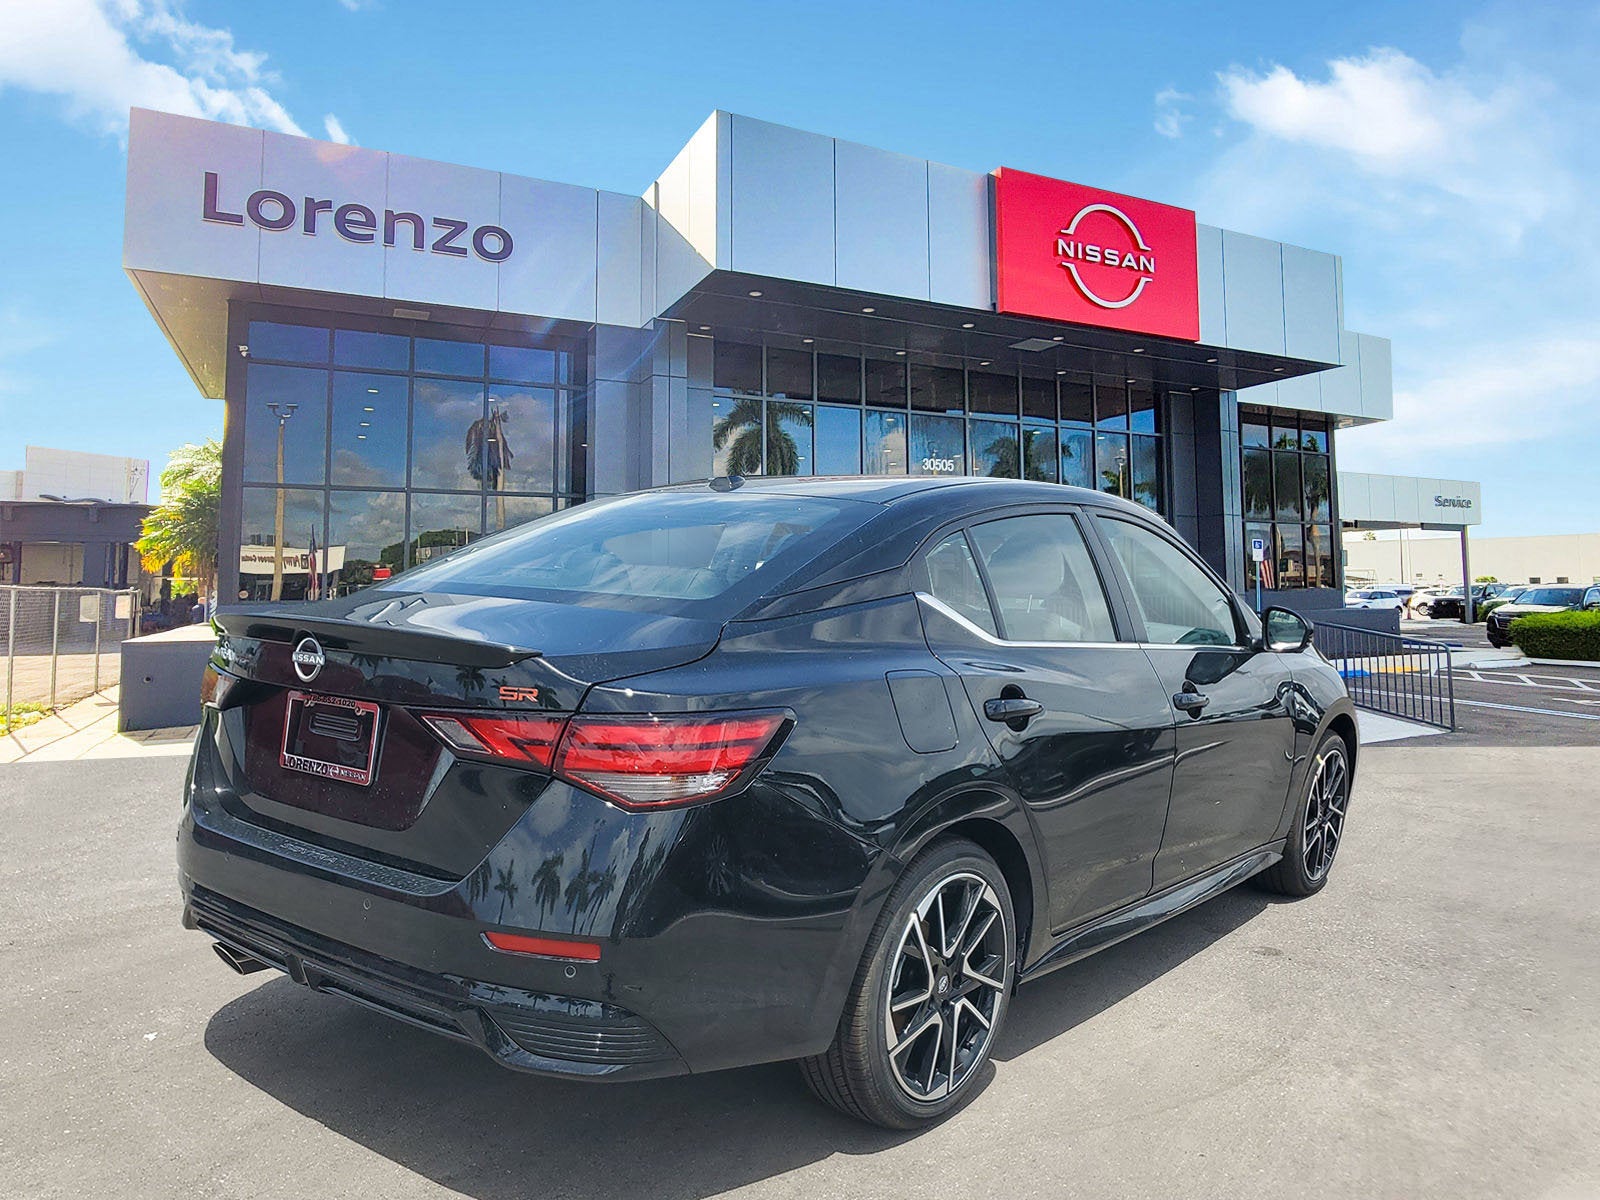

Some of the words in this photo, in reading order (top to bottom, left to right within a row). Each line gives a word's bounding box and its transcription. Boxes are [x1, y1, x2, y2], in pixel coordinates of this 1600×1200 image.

[202, 170, 514, 262] Lorenzo
[1057, 238, 1155, 273] NISSAN
[922, 457, 955, 472] 30505
[1434, 495, 1472, 509] Service
[292, 651, 325, 665] NISSAN
[499, 686, 539, 703] SR
[283, 756, 330, 776] LORENZO
